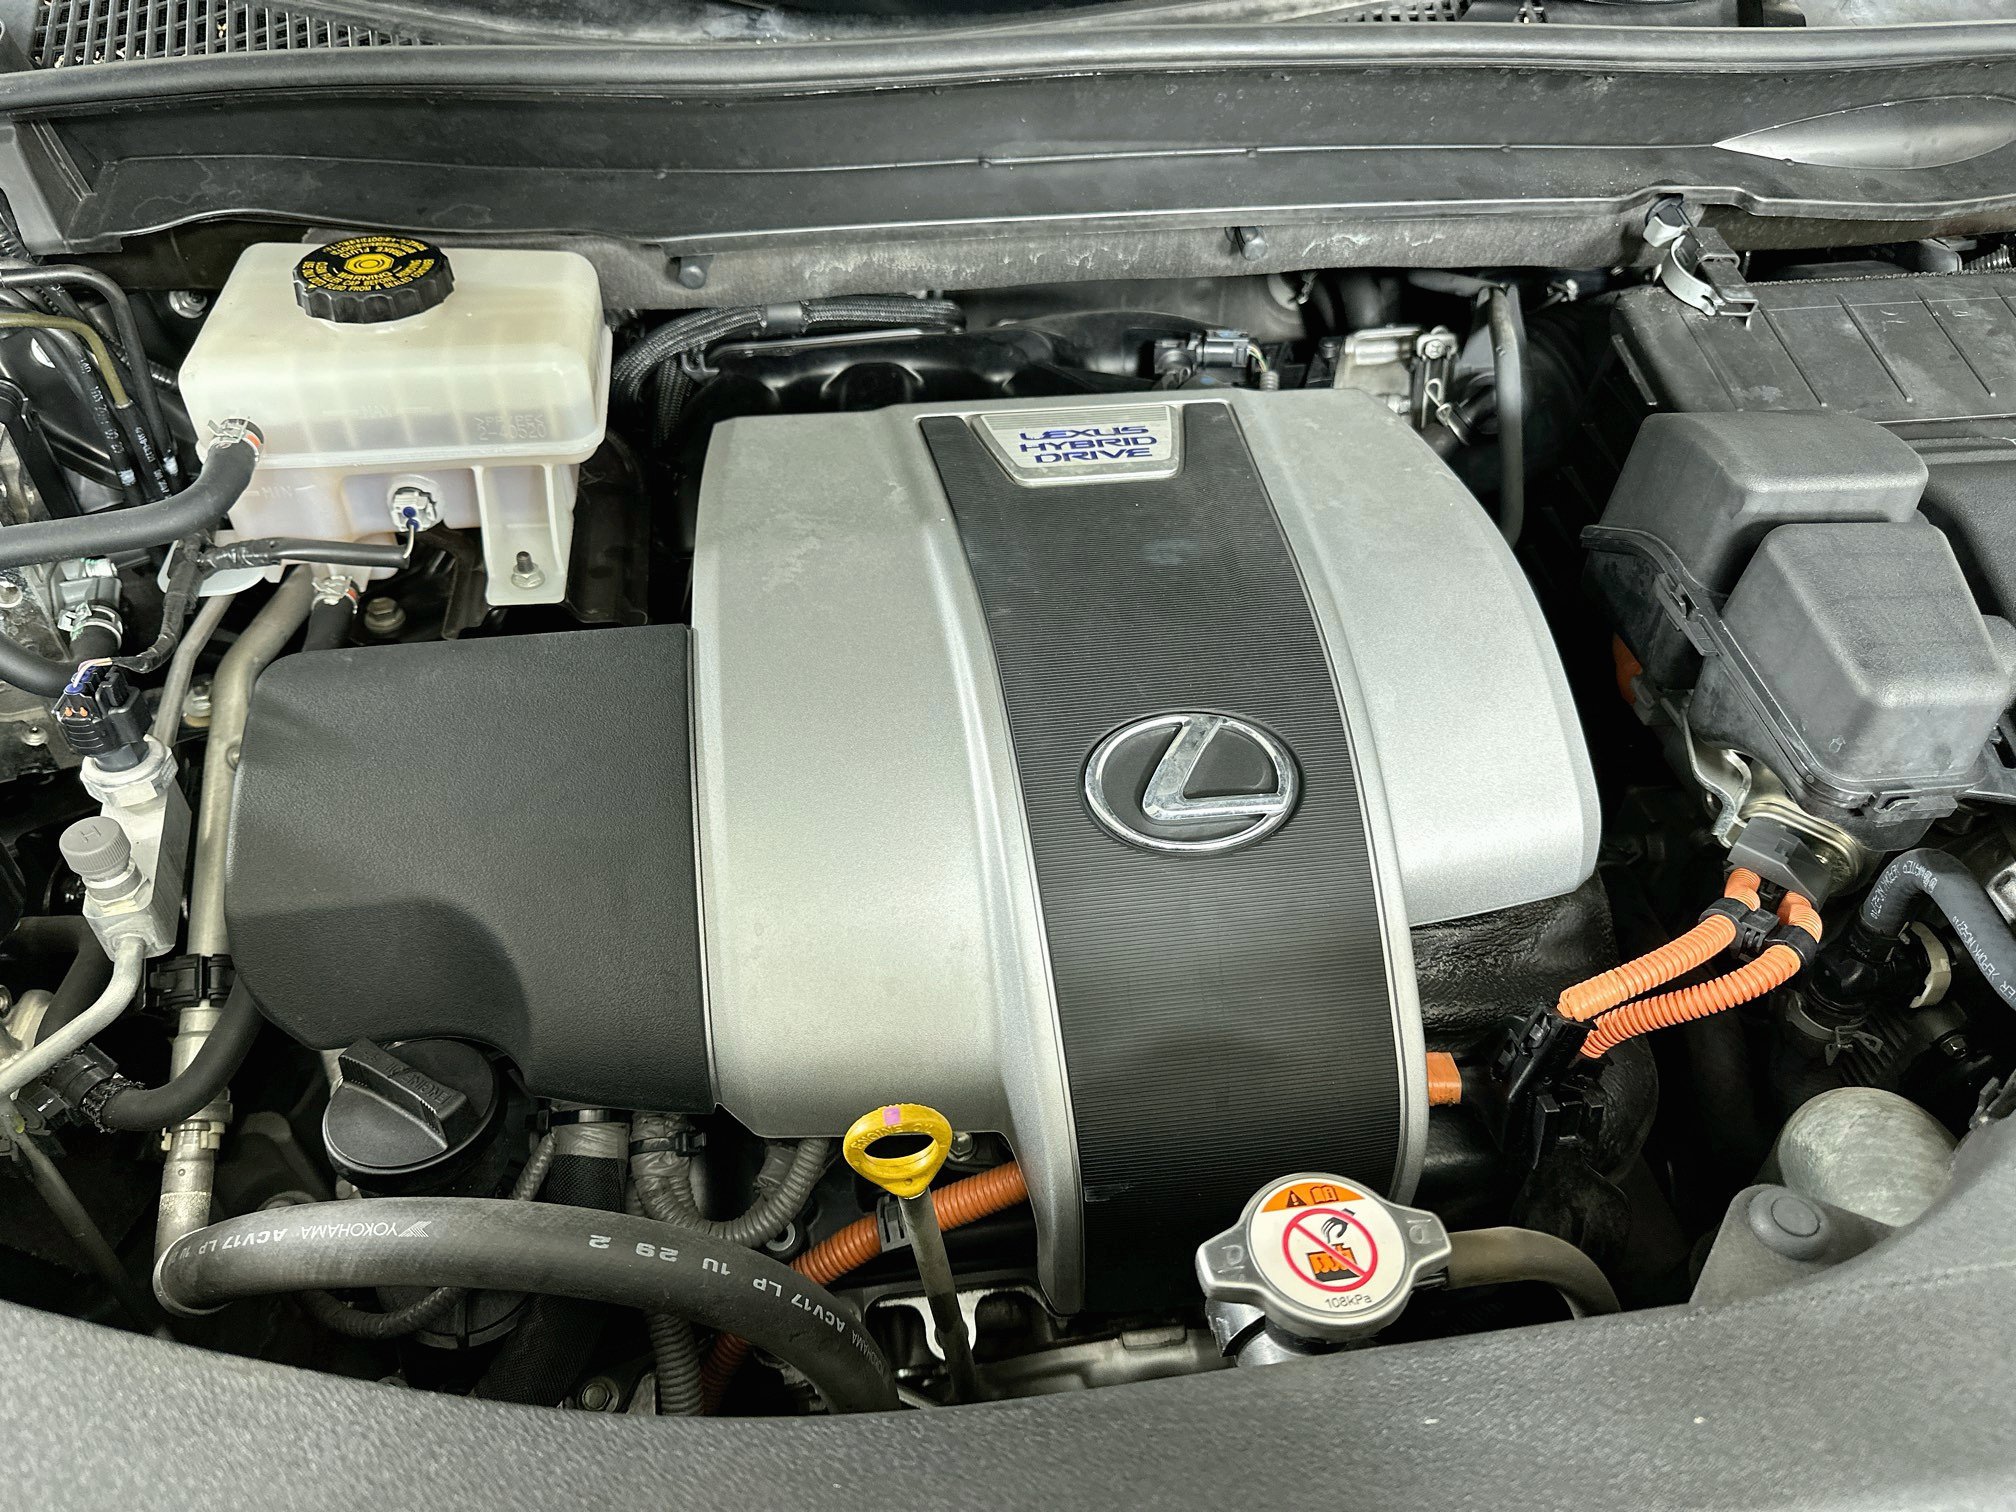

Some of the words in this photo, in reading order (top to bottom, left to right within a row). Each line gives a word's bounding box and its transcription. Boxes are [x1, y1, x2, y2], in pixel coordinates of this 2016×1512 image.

[1019, 425, 1149, 441] LEXUS
[1019, 436, 1157, 453] HYBRID
[1035, 447, 1153, 464] DRIVE
[401, 1068, 452, 1105] ENGINE
[849, 1123, 904, 1150] ENGINE
[222, 1227, 288, 1250] ACV17
[301, 1221, 399, 1240] YOKOHAMA
[198, 1240, 216, 1255] LP
[588, 1233, 612, 1249] 2
[635, 1242, 679, 1263] 29
[701, 1257, 731, 1276] 1U
[752, 1277, 783, 1298] LP
[1324, 1293, 1373, 1309] 108kPa
[791, 1293, 846, 1333] ACV17
